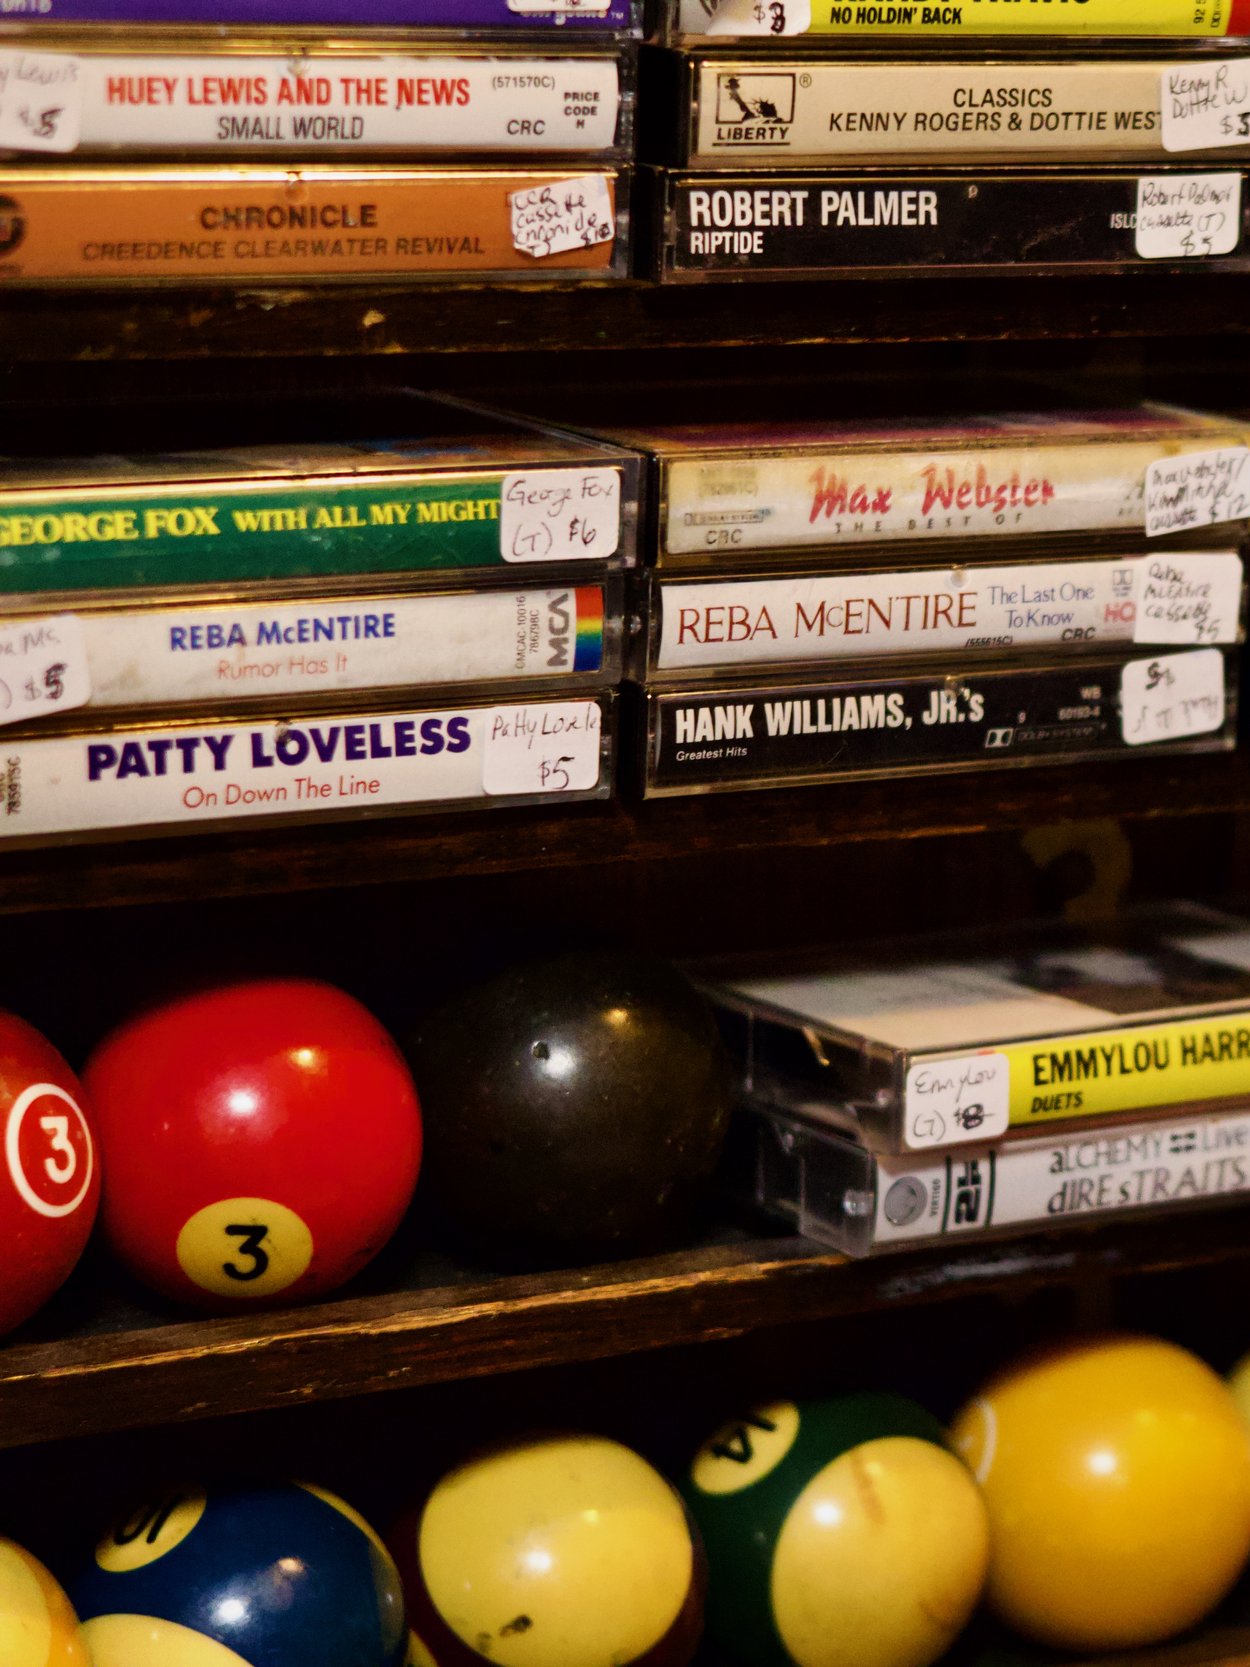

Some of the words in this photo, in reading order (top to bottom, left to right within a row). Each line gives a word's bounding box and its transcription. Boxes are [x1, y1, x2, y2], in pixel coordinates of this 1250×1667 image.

[830, 7, 852, 24] NO
[856, 7, 918, 24] HOLDIN'
[921, 7, 962, 24] BACK
[106, 76, 178, 106] HUEY
[187, 76, 267, 106] LEWIS
[277, 77, 331, 106] AND
[340, 77, 387, 106] THE
[397, 77, 471, 107] NEWS
[563, 91, 600, 103] PRICE
[953, 88, 1053, 108] CLASSICS
[563, 105, 597, 117] CODE
[829, 111, 908, 132] KENNY
[913, 111, 1001, 132] ROGERS
[1007, 112, 1022, 132] &
[1029, 111, 1107, 131] DOTTIE
[217, 116, 285, 140] SMALL
[293, 116, 364, 140] WORLD
[506, 119, 546, 136] CRC
[716, 126, 790, 142] LIBERTY
[200, 203, 378, 231] CHRONICLE
[689, 190, 809, 227] ROBERT
[821, 190, 938, 226] PALMER
[81, 241, 227, 261] CREEDENCE
[233, 238, 387, 259] CLEARWATER
[394, 236, 487, 256] REVIVAL
[690, 231, 764, 254] RIPTIDE
[506, 480, 573, 517] George
[582, 476, 614, 498] Fox
[809, 464, 892, 523] Max
[920, 462, 1055, 516] Webster
[144, 506, 221, 539] FOX
[231, 507, 308, 532] WITH
[312, 505, 367, 529] ALL
[369, 503, 411, 525] MY
[416, 498, 500, 524] MIGHT
[836, 519, 882, 533] THE
[908, 515, 969, 531] BEST
[995, 512, 1023, 526] OF
[512, 522, 553, 557] (T)
[705, 529, 743, 545] CRC
[987, 585, 1018, 606] The
[1022, 583, 1056, 604] Last
[1060, 581, 1096, 601] One
[169, 622, 247, 652] REBA
[256, 612, 396, 646] McENTIRE
[547, 592, 570, 668] MCA
[677, 604, 778, 645] REBA
[794, 592, 977, 638] McENTIRE
[1005, 609, 1023, 629] To
[1025, 608, 1075, 627] Know
[1060, 626, 1096, 642] CRC
[217, 658, 283, 681] Rumor
[288, 654, 328, 676] Has
[335, 653, 348, 674] It
[675, 704, 754, 744] HANK
[764, 692, 913, 737] WILLIAMS,
[87, 733, 235, 782] PATTY
[250, 716, 472, 768] LOVELESS
[676, 748, 723, 761] Greatest
[726, 746, 748, 757] Hits
[537, 754, 575, 790] $5
[183, 786, 217, 809] On
[225, 783, 288, 806] Down
[294, 777, 332, 800] The
[339, 775, 381, 797] Line
[1032, 1038, 1170, 1087] EMMYLOU
[1031, 1091, 1083, 1114] DUETS
[40, 1116, 76, 1184] 3
[222, 1224, 269, 1281] 3
